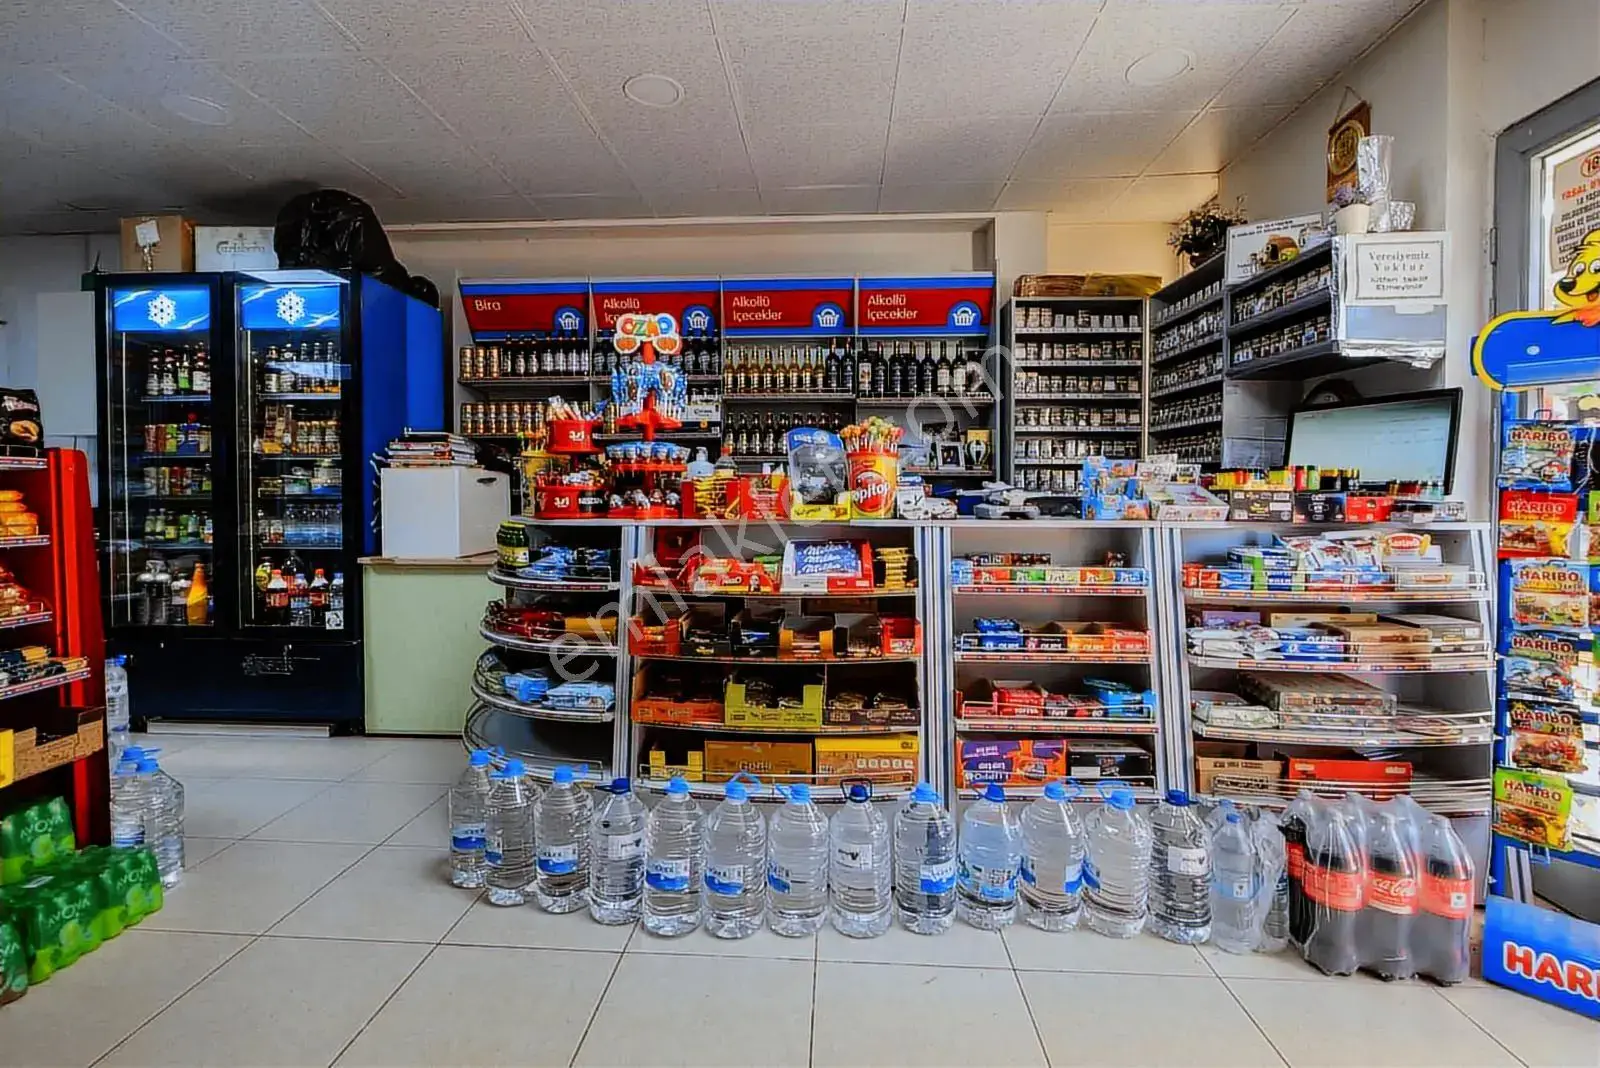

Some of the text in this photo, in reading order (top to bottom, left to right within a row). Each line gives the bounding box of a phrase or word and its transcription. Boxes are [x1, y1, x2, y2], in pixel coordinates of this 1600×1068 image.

[475, 299, 501, 311] Bira
[603, 297, 640, 310] Alkollü
[733, 296, 770, 308] Alkollü
[867, 294, 906, 306] Alkollü
[1511, 430, 1569, 442] HARIBO
[1508, 500, 1566, 514] HARIBO
[803, 543, 844, 555] Milka
[1519, 570, 1579, 582] HARIBO
[1512, 637, 1572, 652] HARIBO
[1514, 710, 1571, 725] HARIBO
[1504, 780, 1562, 802] HARIBO
